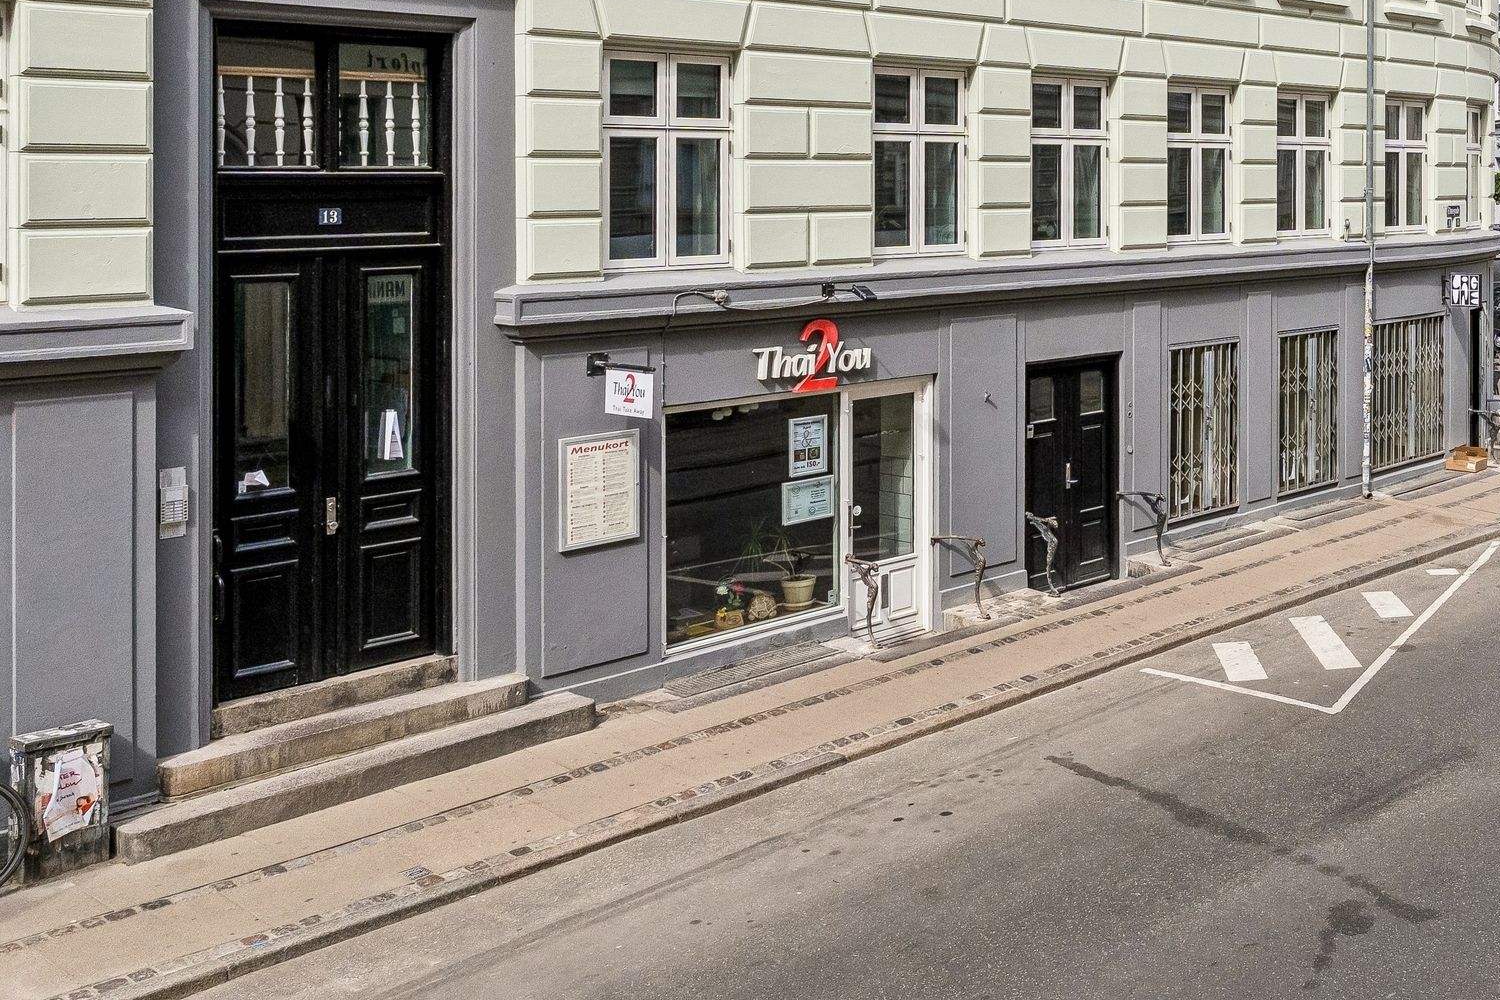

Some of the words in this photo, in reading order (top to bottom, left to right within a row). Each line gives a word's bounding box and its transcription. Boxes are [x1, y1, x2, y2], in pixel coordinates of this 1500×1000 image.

[323, 210, 338, 224] 13
[752, 343, 818, 380] Thai
[791, 319, 838, 393] 2
[826, 340, 871, 373] You
[613, 381, 630, 397] Thai
[623, 373, 635, 403] 2
[570, 440, 630, 455] Menukort
